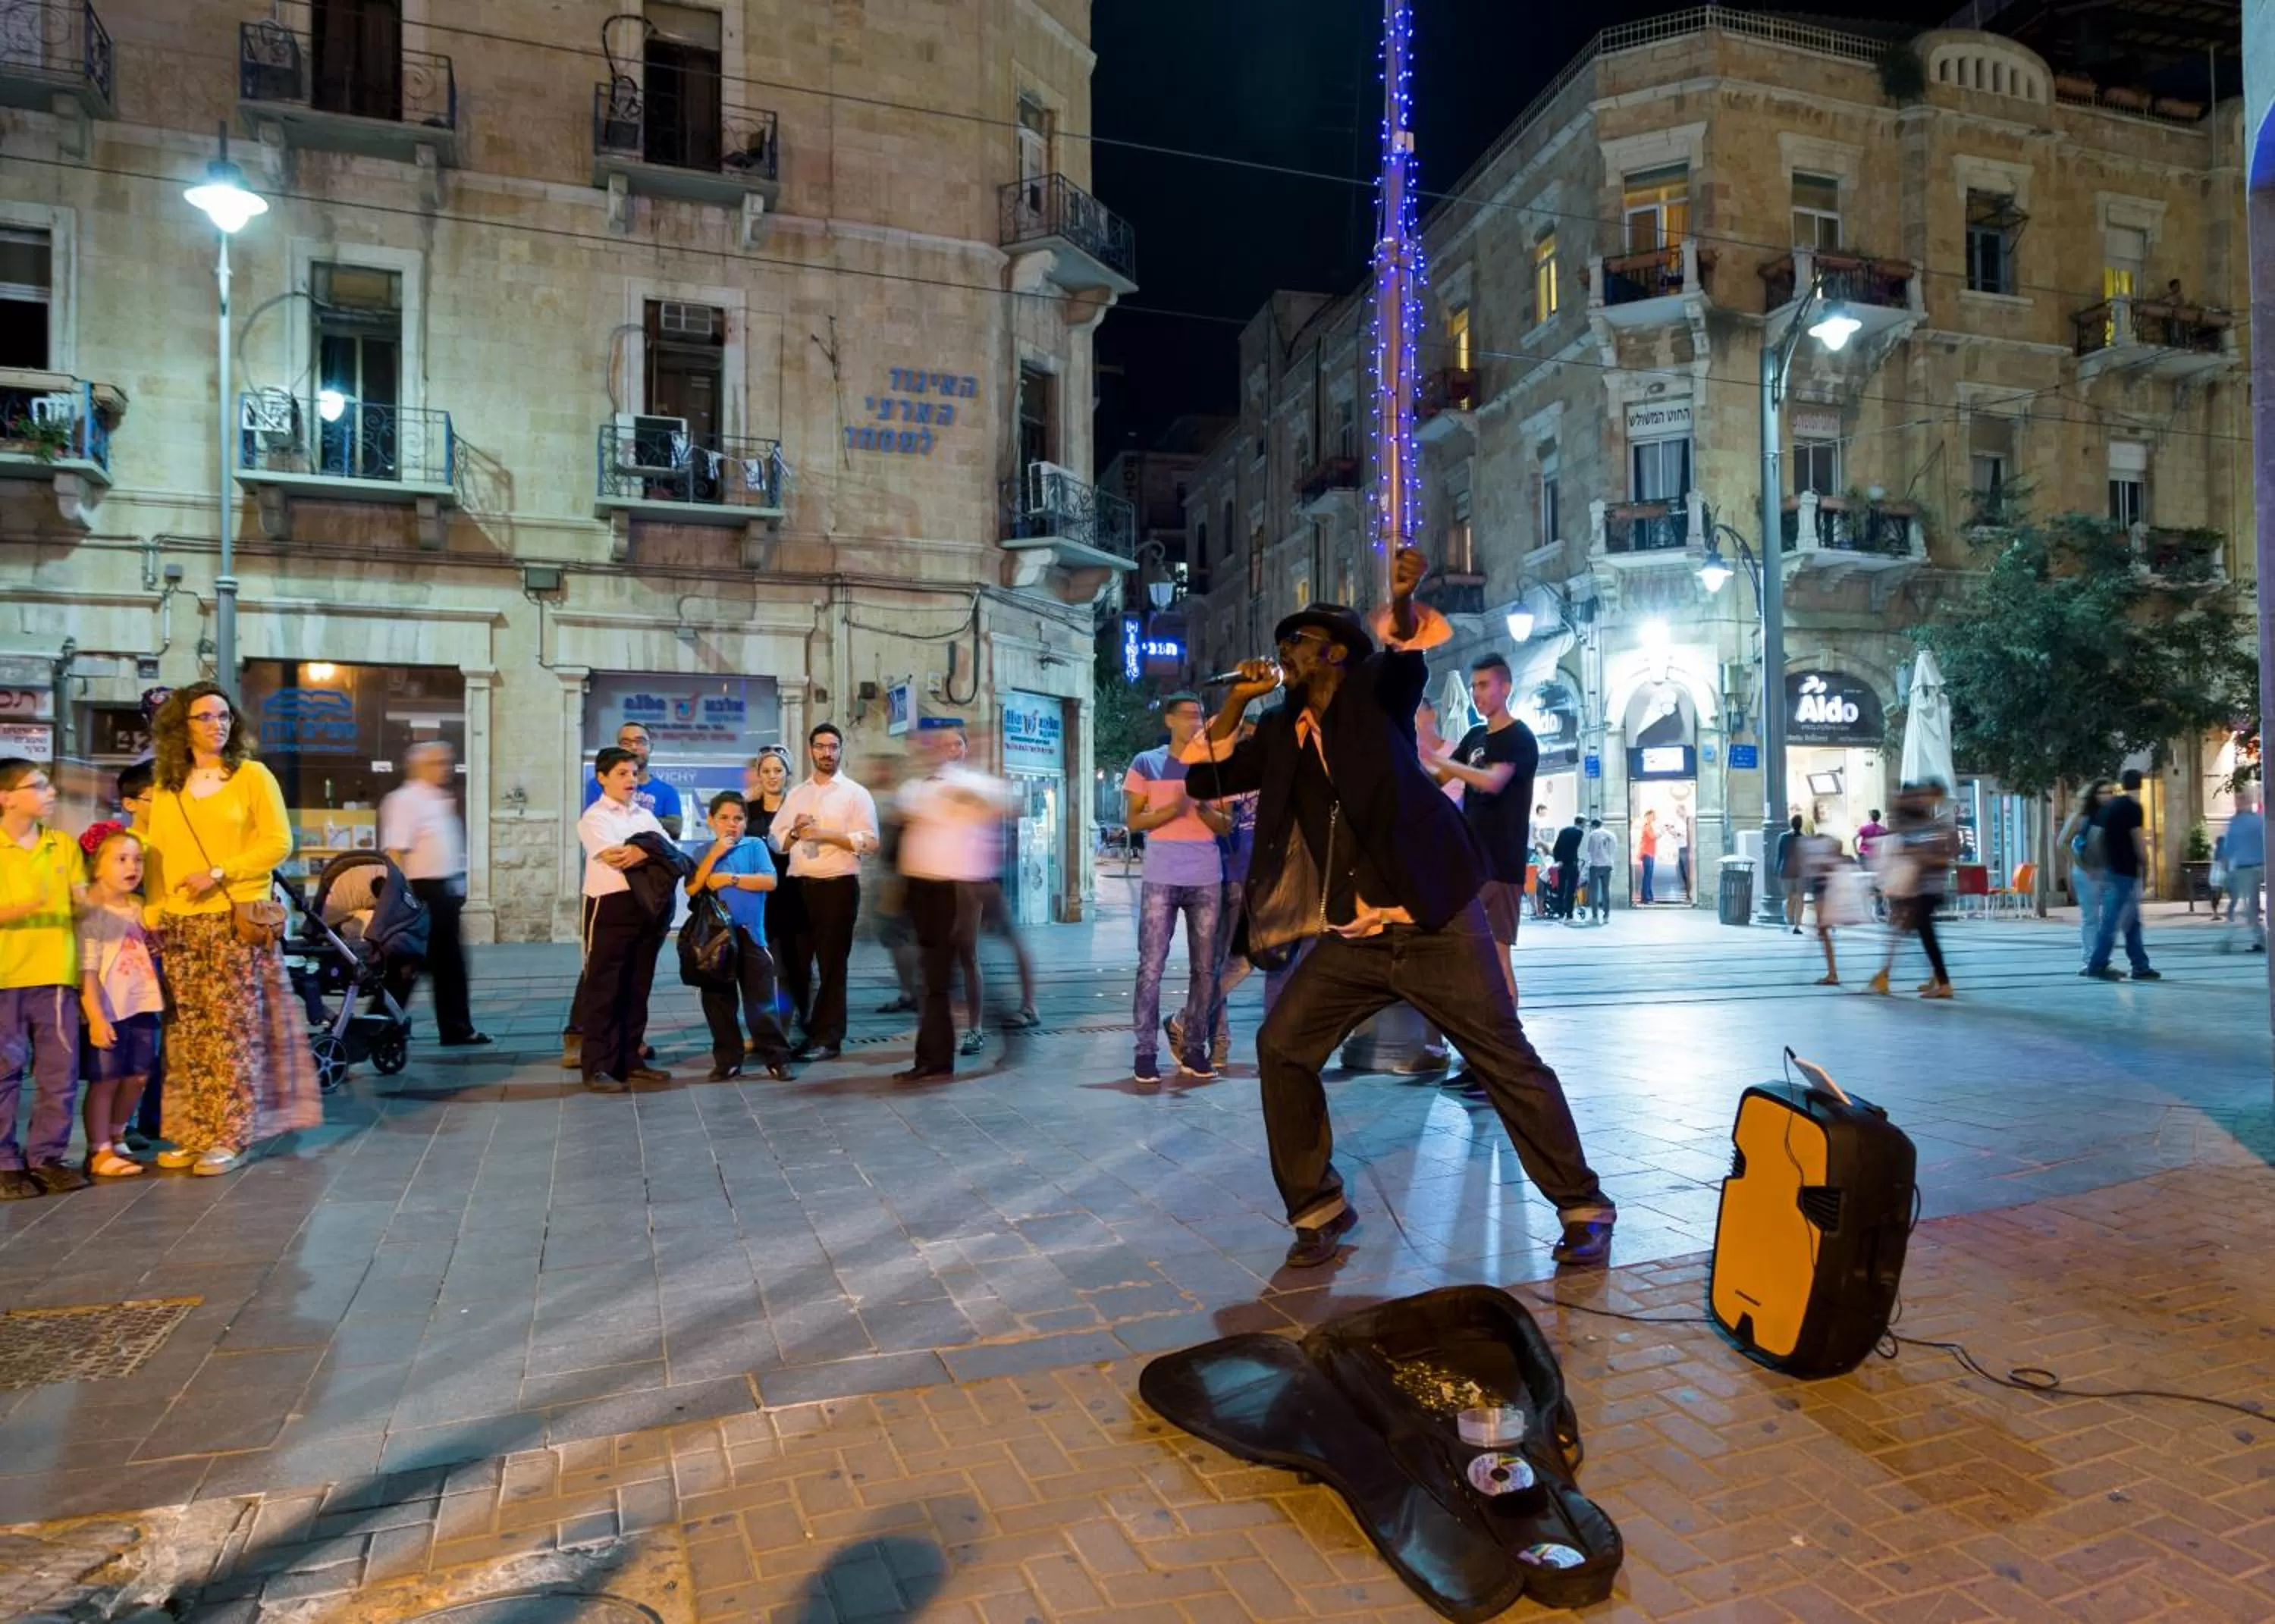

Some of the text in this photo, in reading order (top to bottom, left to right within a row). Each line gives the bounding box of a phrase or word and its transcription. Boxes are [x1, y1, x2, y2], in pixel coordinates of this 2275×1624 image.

[890, 367, 978, 398] האיגוד
[864, 396, 954, 426] הארצי
[844, 426, 935, 455] למסחר
[1794, 694, 1859, 723] Aldo
[654, 768, 698, 784] VICHY
